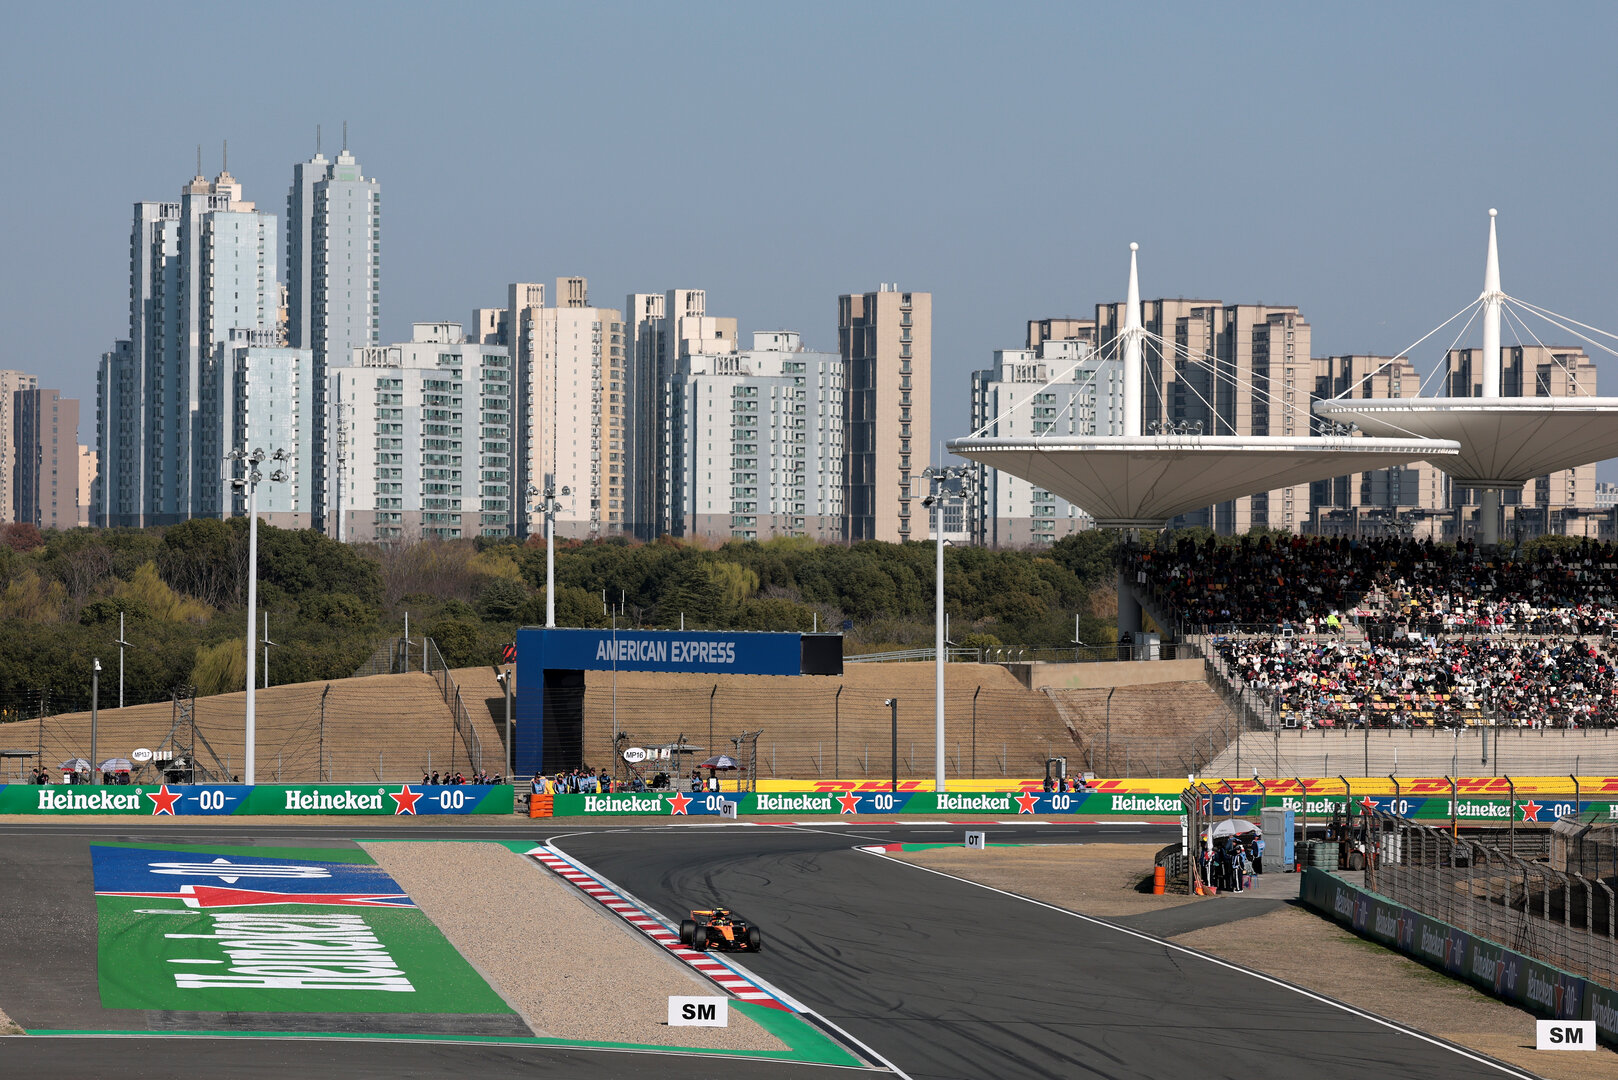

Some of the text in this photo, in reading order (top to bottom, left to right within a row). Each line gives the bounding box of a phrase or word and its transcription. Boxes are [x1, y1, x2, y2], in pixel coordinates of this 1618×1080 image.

[596, 640, 736, 663] AMERICAN EXPRESS
[626, 751, 644, 759] MP16
[1410, 779, 1516, 792] DHL
[38, 789, 224, 810] Heineken 0.0
[285, 789, 464, 810] Heineken 0.0
[584, 795, 661, 812] Heineken
[757, 794, 893, 810] Heineken 0.0
[937, 794, 1070, 810] Heineken 0.0
[1111, 795, 1182, 811] Heineken
[723, 804, 732, 814] OT
[968, 835, 979, 845] OT
[682, 1003, 716, 1020] SM
[1549, 1027, 1584, 1044] SM
